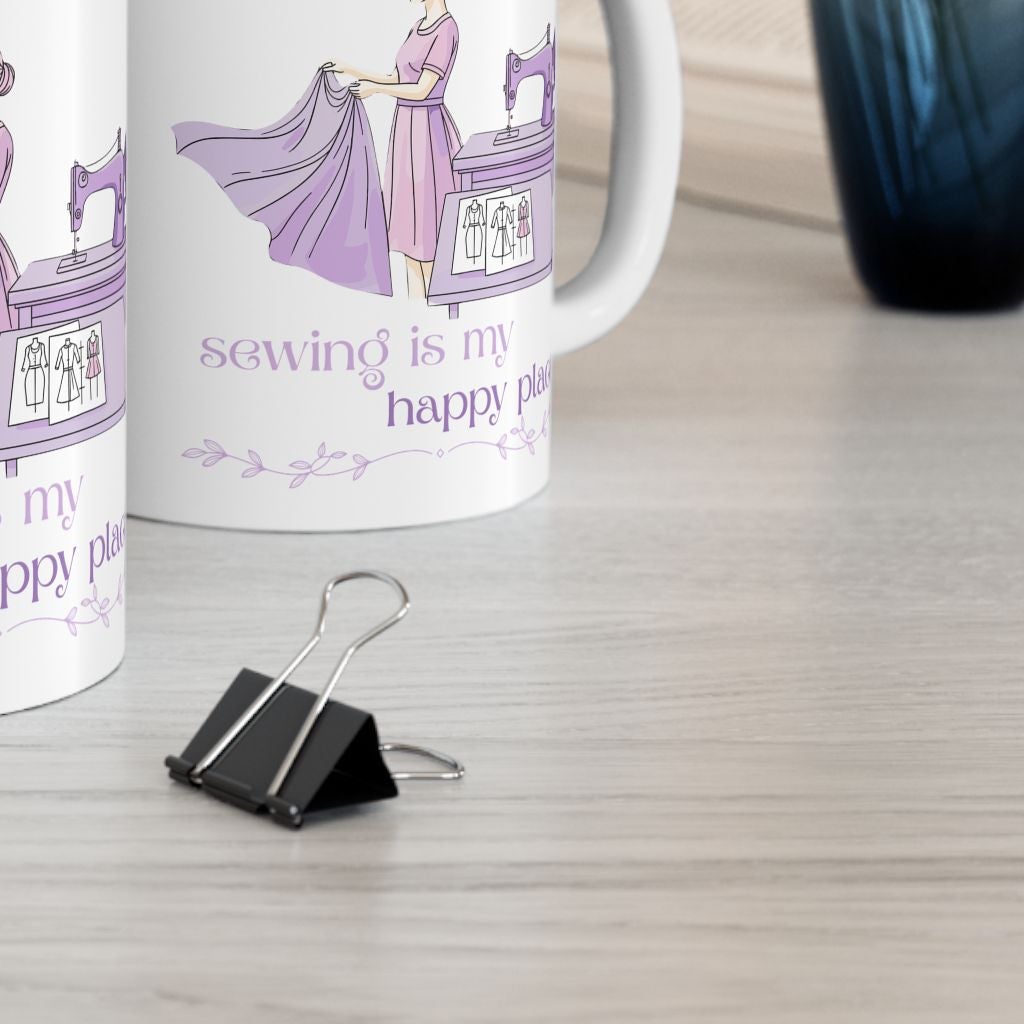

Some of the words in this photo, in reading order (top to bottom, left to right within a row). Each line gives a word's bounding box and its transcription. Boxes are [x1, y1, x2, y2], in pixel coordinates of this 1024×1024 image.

[200, 328, 390, 390] sewing
[410, 325, 445, 367] is
[463, 320, 515, 368] my
[387, 382, 508, 432] happy
[517, 359, 552, 416] plac
[24, 474, 84, 531] my
[88, 513, 126, 584] plac
